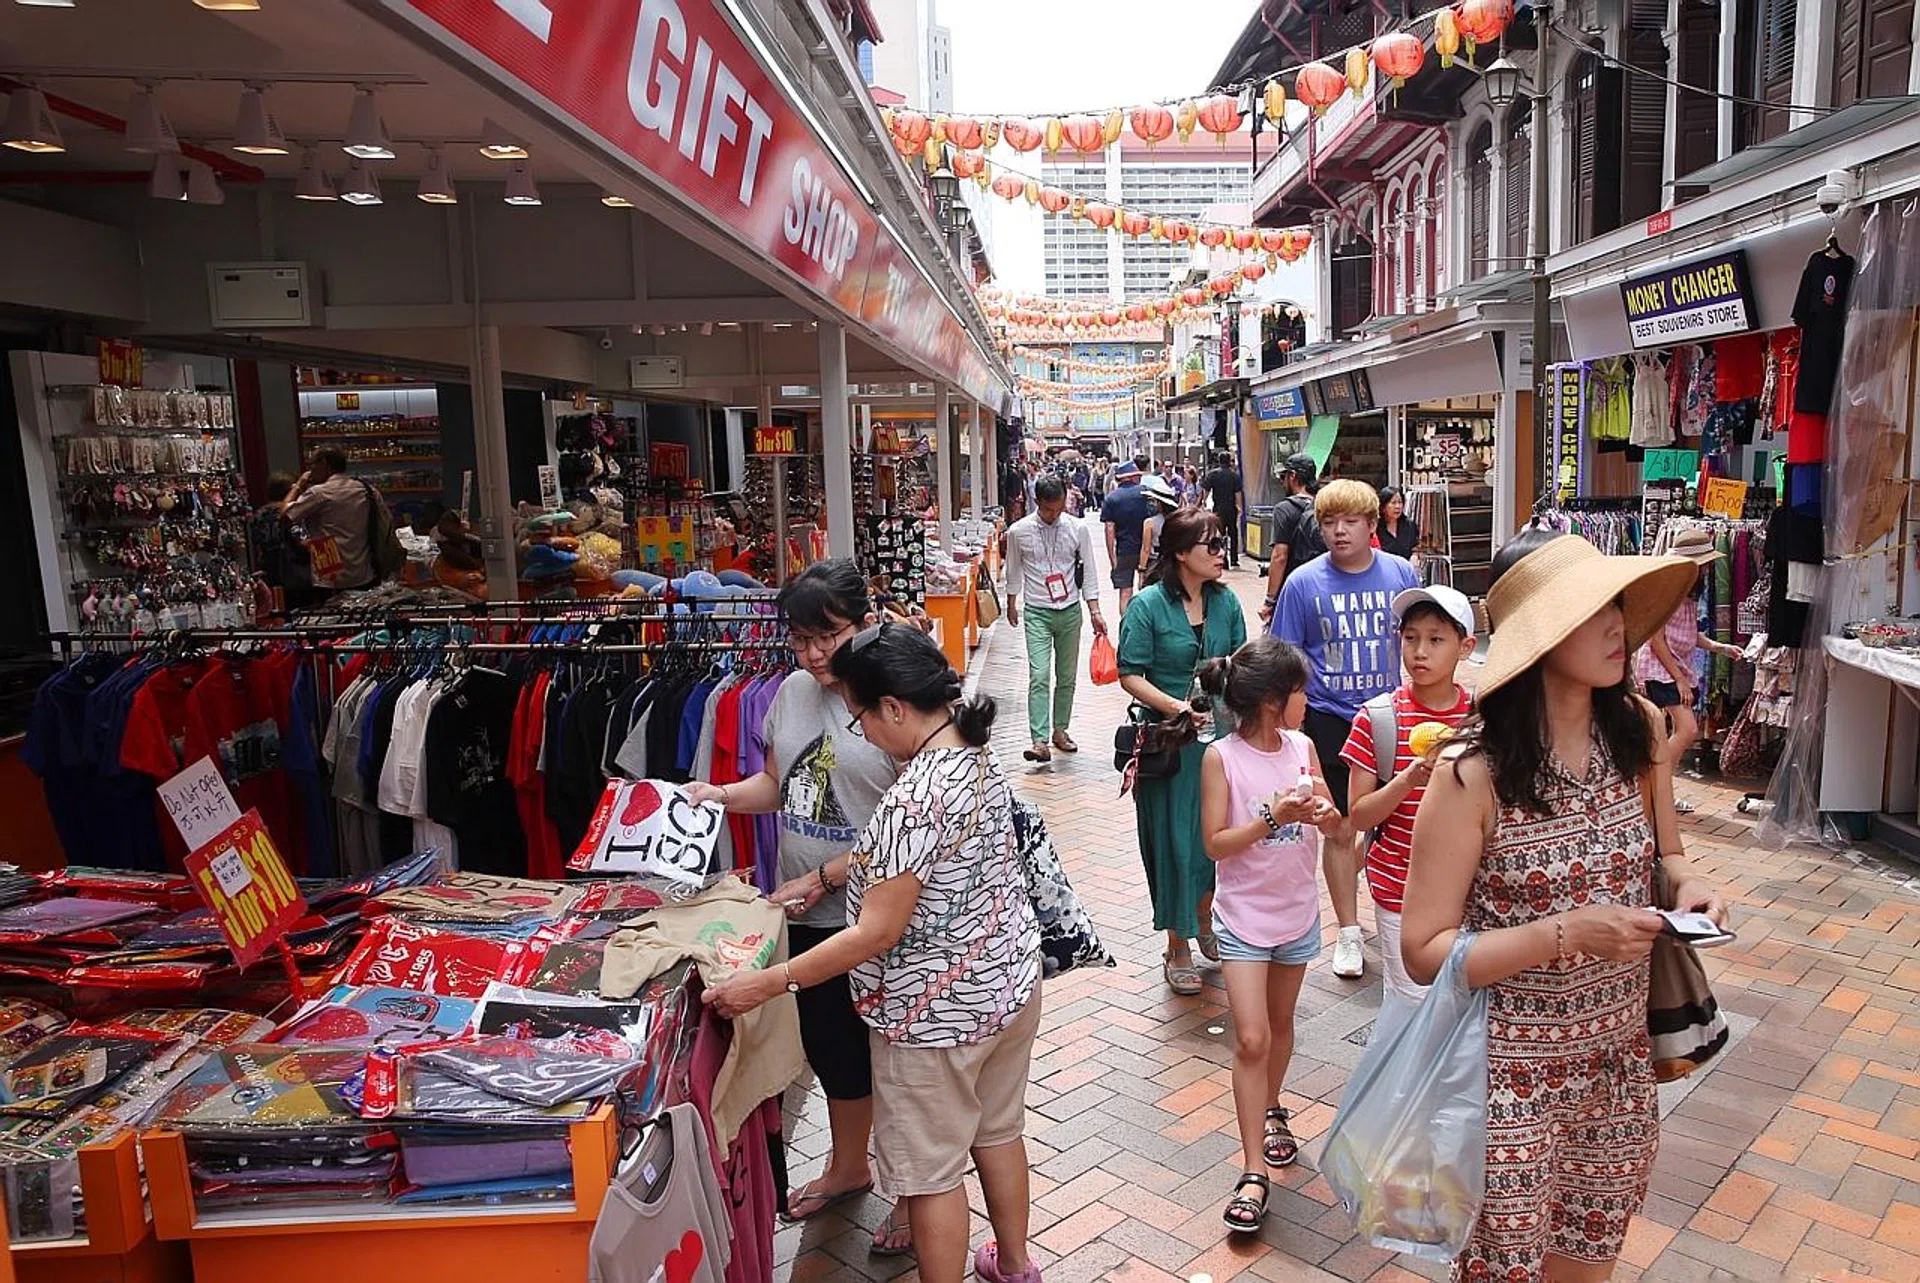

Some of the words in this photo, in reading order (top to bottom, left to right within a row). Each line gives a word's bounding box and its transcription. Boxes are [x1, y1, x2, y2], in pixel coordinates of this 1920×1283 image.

[626, 0, 773, 208] GIFT
[783, 156, 859, 281] SHOP
[1626, 281, 1667, 316] MONEY
[1672, 263, 1737, 306] CHANGER
[1636, 322, 1655, 338] BEST
[1658, 312, 1704, 333] SOUVENIRS
[1707, 305, 1739, 324] STORE
[1561, 373, 1578, 429] MONEY
[755, 430, 763, 452] 3
[775, 429, 794, 452] $10
[1439, 439, 1459, 455] $5
[1315, 596, 1322, 615] I
[1320, 611, 1386, 640] DANC
[802, 822, 858, 842] WARS
[199, 867, 247, 948] 5
[232, 887, 269, 938] for
